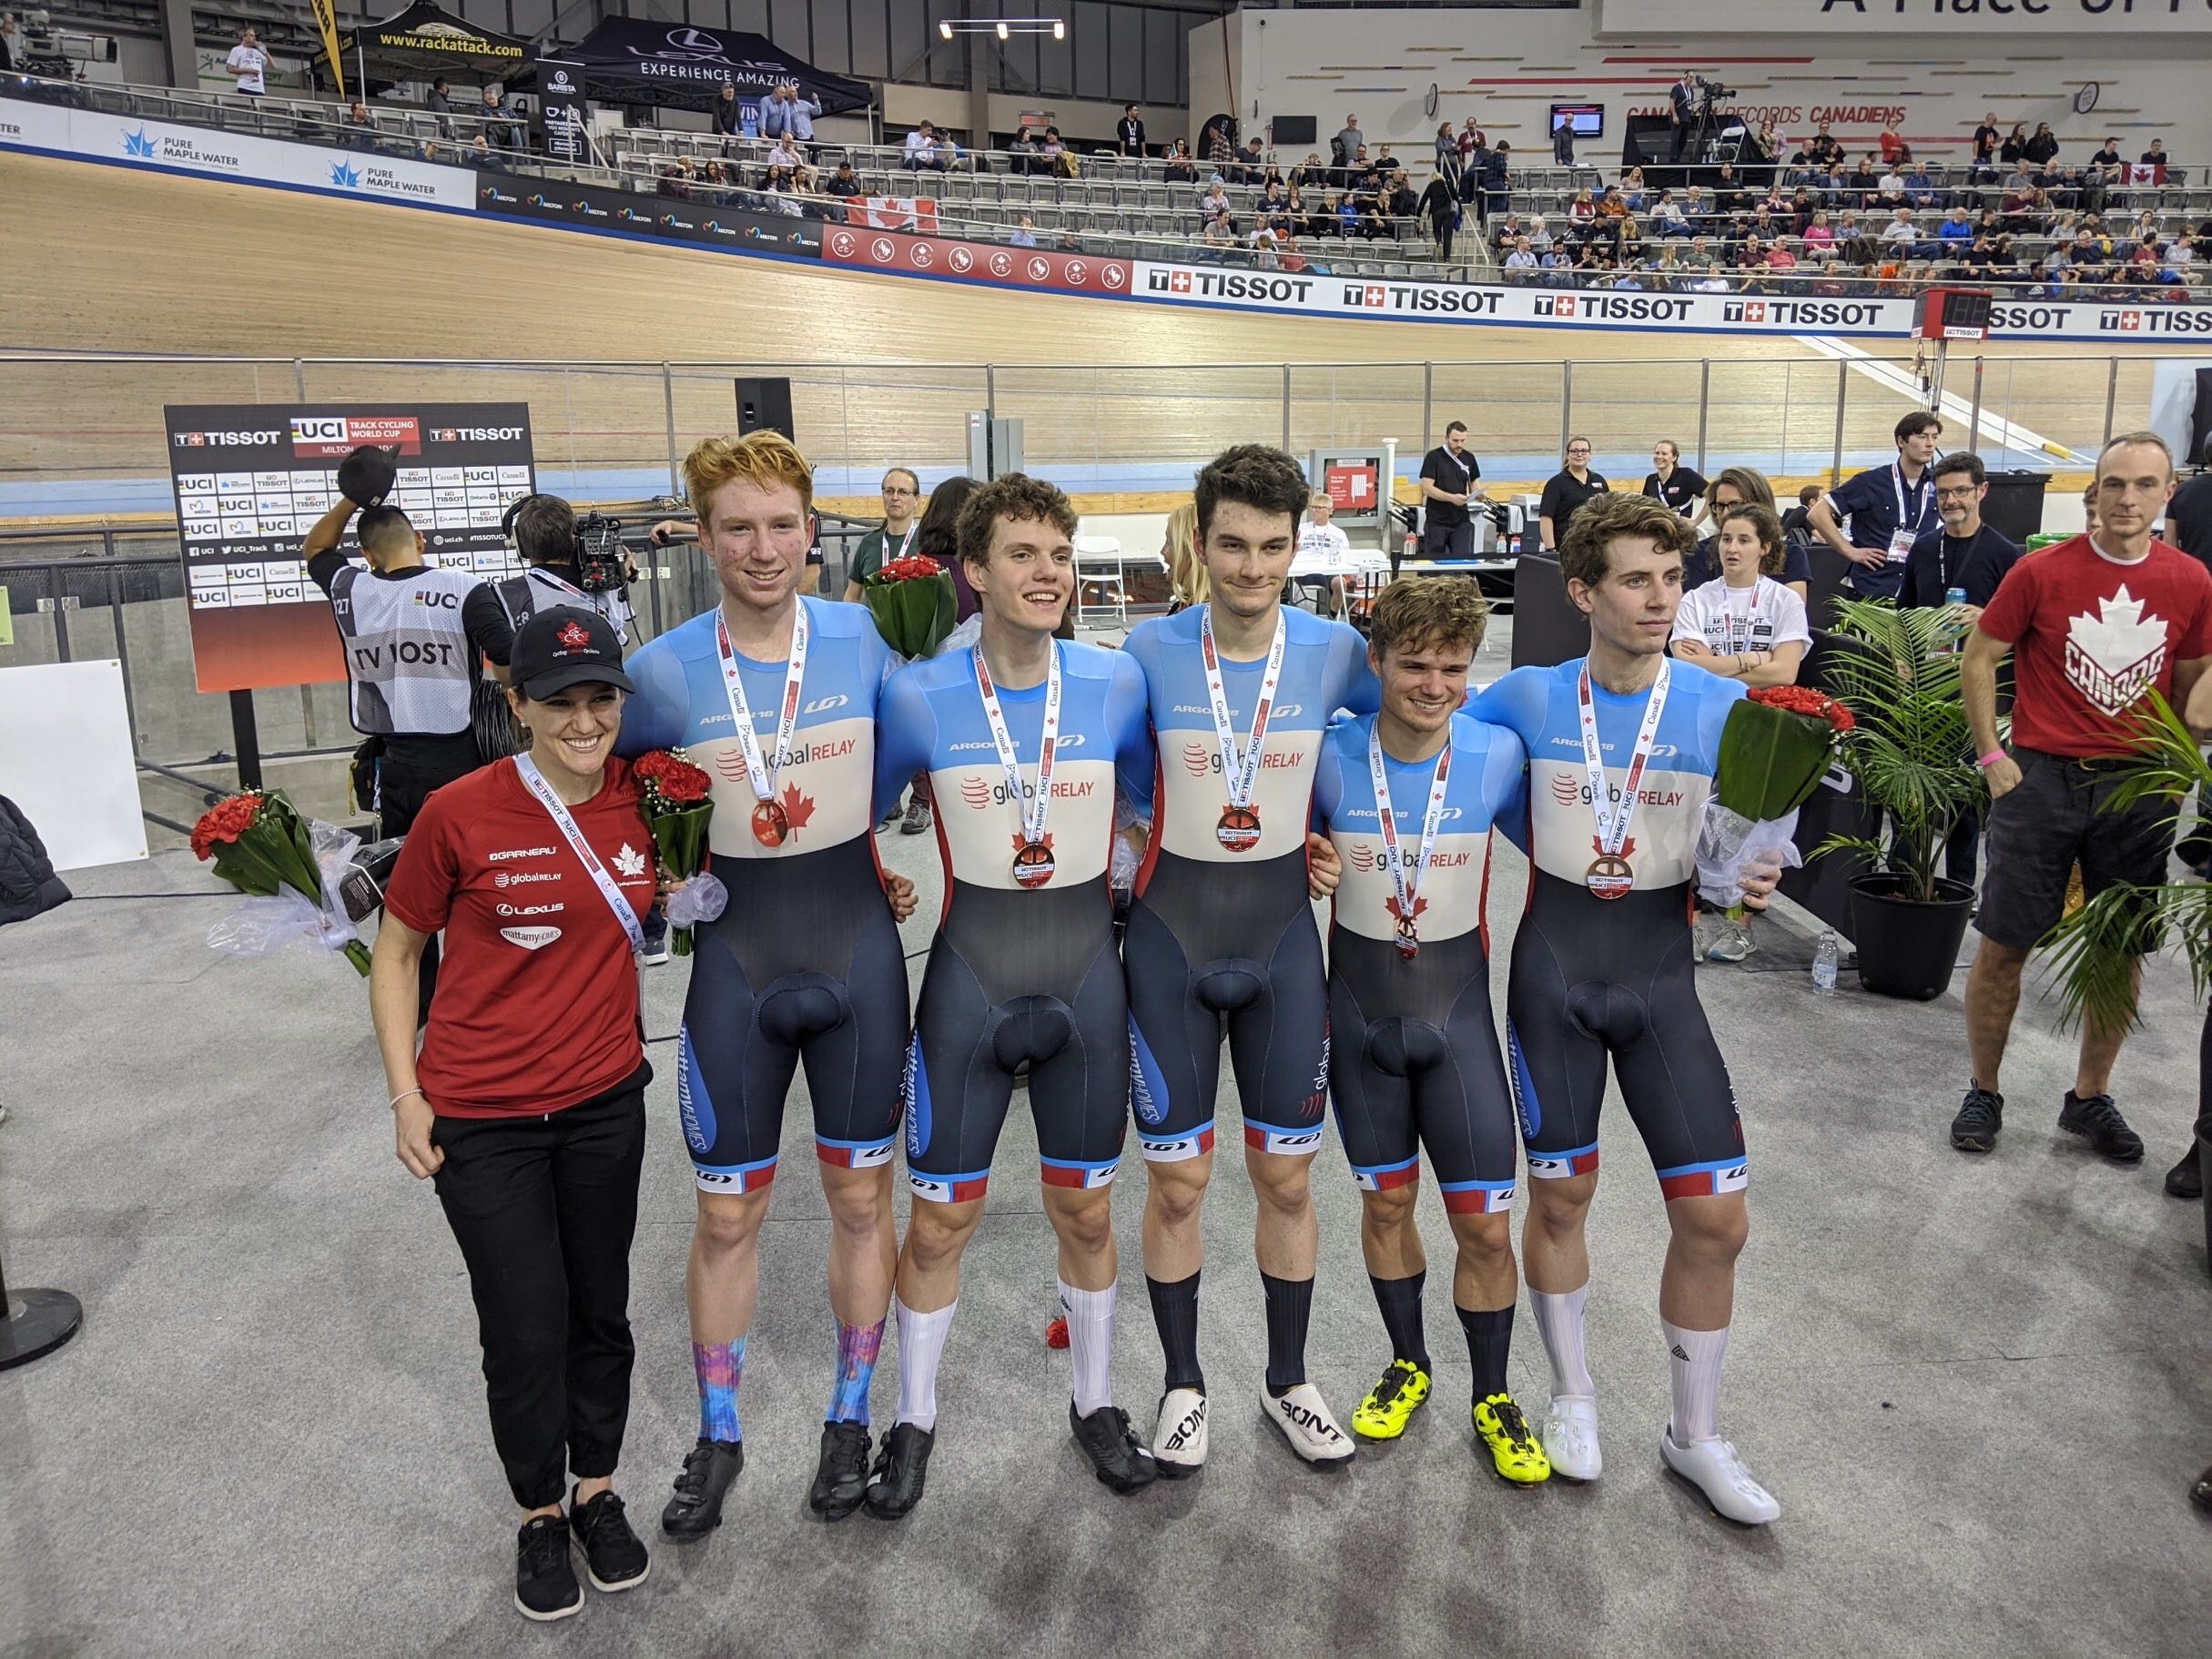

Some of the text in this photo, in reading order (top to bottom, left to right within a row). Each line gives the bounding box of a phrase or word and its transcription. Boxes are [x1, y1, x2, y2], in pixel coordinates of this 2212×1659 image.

[379, 33, 523, 57] www.rackattack.com
[624, 46, 788, 72] LEXUS
[641, 62, 801, 88] EXPERIENCE AMAZING
[547, 83, 576, 93] BARISTA
[1811, 106, 1907, 124] CANADIENS
[165, 137, 193, 149] PURE
[163, 147, 200, 160] MAPLE
[202, 153, 238, 167] WATER
[368, 167, 393, 179] PURE
[367, 177, 401, 190] MAPLE
[402, 183, 436, 196] WATER
[1195, 272, 1314, 302] TISSOT
[1388, 287, 1505, 314] TISSOT
[1579, 296, 1695, 320] TISSOT
[1769, 302, 1884, 325] TISSOT
[301, 422, 343, 439] UCI
[379, 420, 414, 429] CYCLING
[379, 430, 401, 438] CUP
[456, 428, 523, 441] TISSOT
[205, 431, 280, 445] TISSOT
[322, 445, 354, 454] MILTON
[185, 479, 212, 490] UCI
[470, 471, 494, 481] UCI
[226, 501, 252, 511] UCI
[190, 524, 218, 534] UCI
[266, 521, 291, 531] UCI
[446, 557, 471, 567] UCI
[234, 568, 260, 579] UCI
[198, 592, 226, 603] UCI
[273, 587, 299, 598] UCI
[797, 626, 805, 651] Canada
[355, 647, 381, 670] TV
[1271, 642, 1283, 670] Canada
[732, 687, 745, 715] Canada
[1050, 680, 1059, 706] Canada
[1215, 700, 1228, 728] Canada
[1648, 698, 1661, 724] Canada
[996, 727, 1010, 754] Canada
[1586, 733, 1598, 761] Canada
[1375, 752, 1383, 779] Canada
[1242, 761, 1254, 791] TISSOT
[543, 788, 578, 838] TISSOT UCI
[1035, 801, 1045, 831] TISSOT
[1614, 815, 1628, 845] TISSOT
[496, 847, 557, 860] GARNEAU
[511, 872, 562, 885] globalRELAY
[1395, 868, 1403, 897] TISSOT
[514, 903, 564, 915] LEXUS
[614, 897, 632, 922] Canada
[502, 928, 560, 943] mattamyHOMES
[1280, 1400, 1344, 1442] BONT
